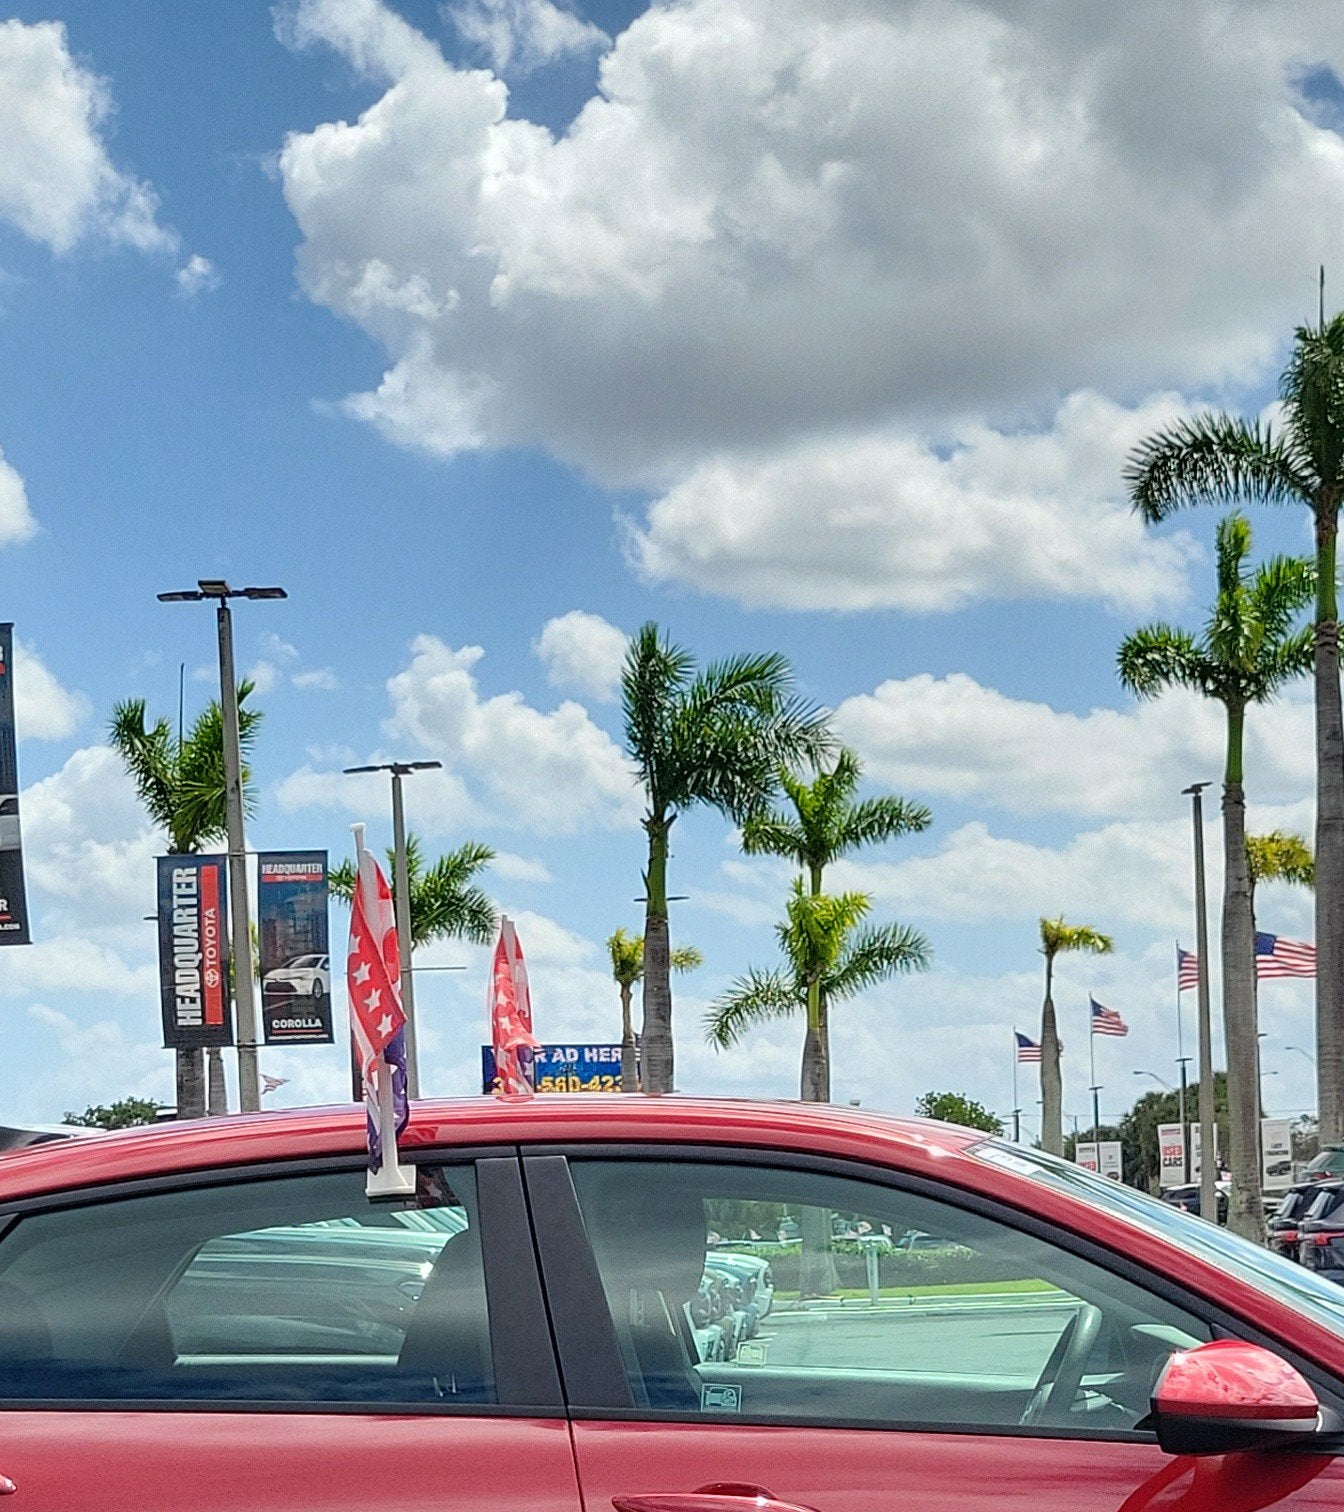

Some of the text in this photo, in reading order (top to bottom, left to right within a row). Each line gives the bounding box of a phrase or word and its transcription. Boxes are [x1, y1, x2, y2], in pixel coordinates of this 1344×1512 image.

[172, 866, 203, 1026] HEADQUARTER
[205, 907, 218, 968] TOYOTA
[272, 1018, 322, 1029] COROLLA
[552, 1047, 579, 1063] AD
